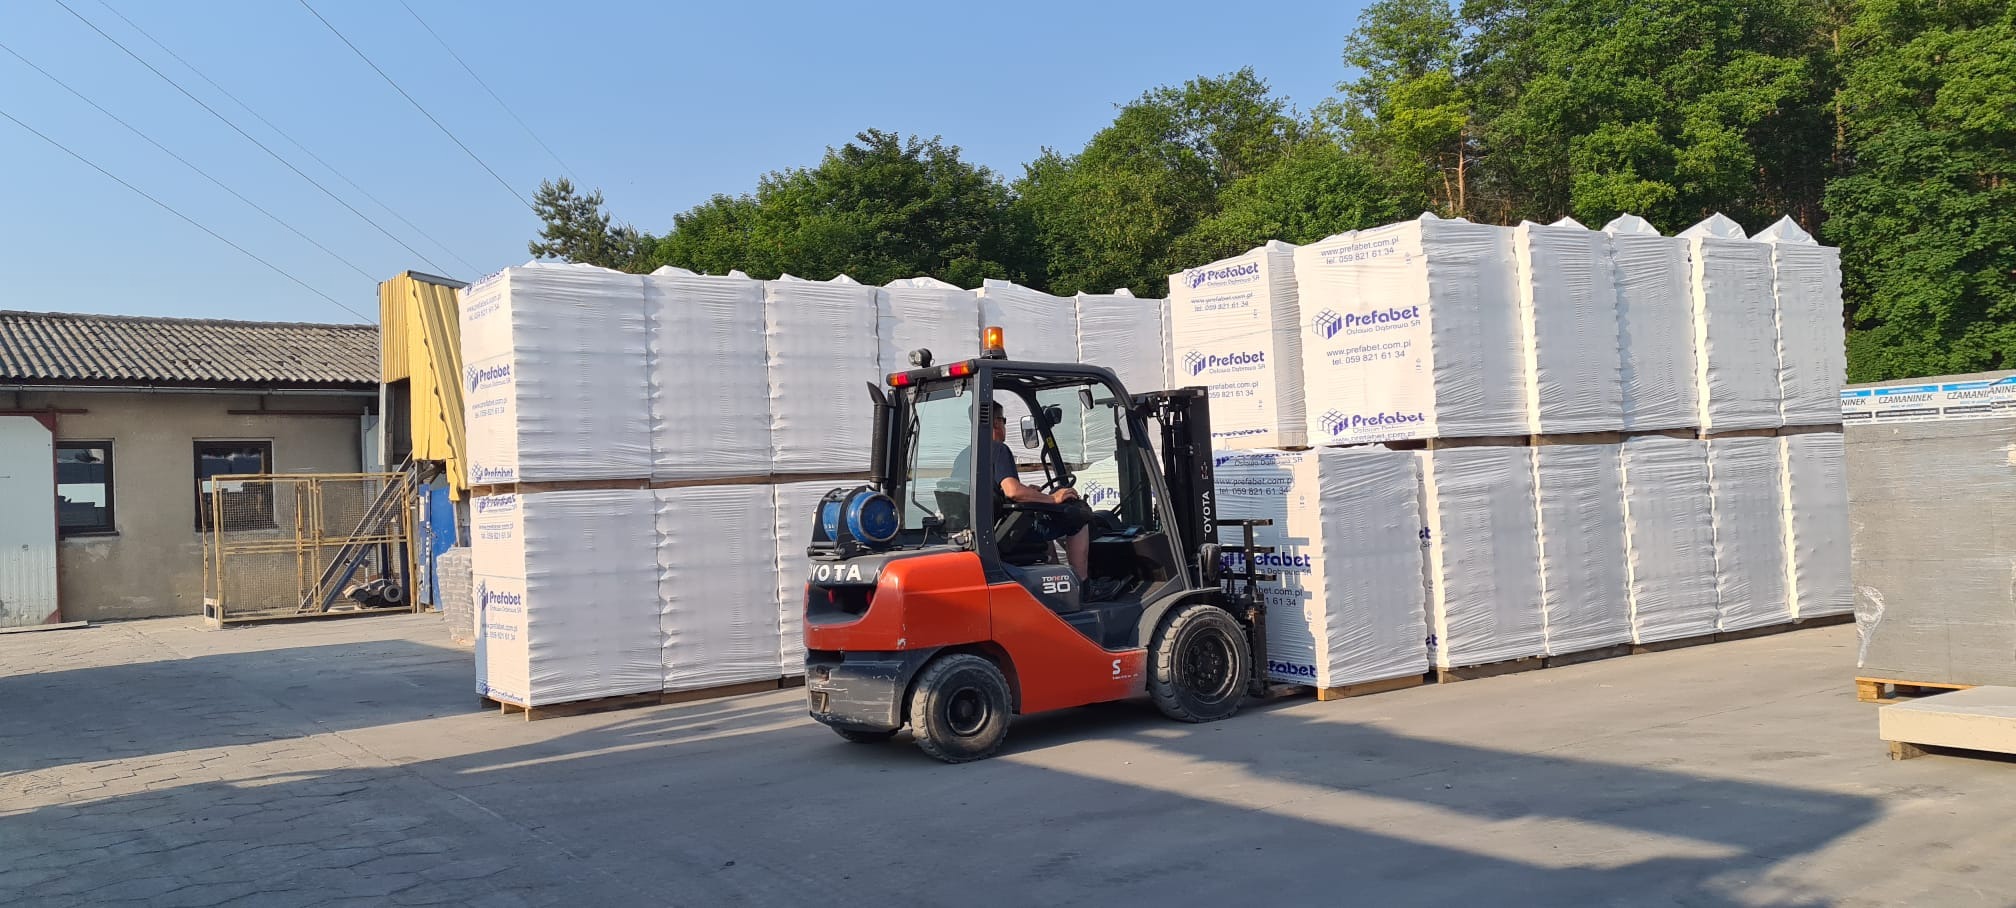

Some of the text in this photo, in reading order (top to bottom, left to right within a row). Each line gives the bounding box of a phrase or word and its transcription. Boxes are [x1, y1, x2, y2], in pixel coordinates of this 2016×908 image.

[1320, 236, 1399, 257] www.prefabet.com.pl
[1326, 247, 1394, 264] tel. 059 821 61 34
[1207, 262, 1259, 280] Prefabet
[1345, 305, 1419, 327] Prefabet
[1327, 339, 1411, 357] www.prefabet.com.pl
[1208, 351, 1265, 367] Prefabet
[1345, 355, 1360, 364] 059
[1363, 353, 1378, 361] 821
[1395, 350, 1405, 358] 34
[479, 363, 510, 382] Prefabet
[1208, 381, 1259, 391] prefabet.com.pl
[1988, 384, 2016, 394] ANINE
[1841, 398, 1867, 406] NINEK
[1879, 393, 1933, 405] CZAMANINEK
[1946, 390, 1990, 400] CZAMANI
[1352, 411, 1425, 427] Prefabet
[1232, 487, 1247, 495] 059
[1249, 487, 1263, 495] 821
[1266, 487, 1276, 495] 61
[1279, 486, 1289, 495] 34
[1239, 551, 1311, 567] Pefabet
[808, 563, 862, 581] YOTA
[1042, 581, 1070, 594] 30
[490, 590, 521, 605] Prefabet
[1272, 597, 1283, 606] 61
[1286, 598, 1296, 606] 34
[1269, 660, 1316, 678] fabet
